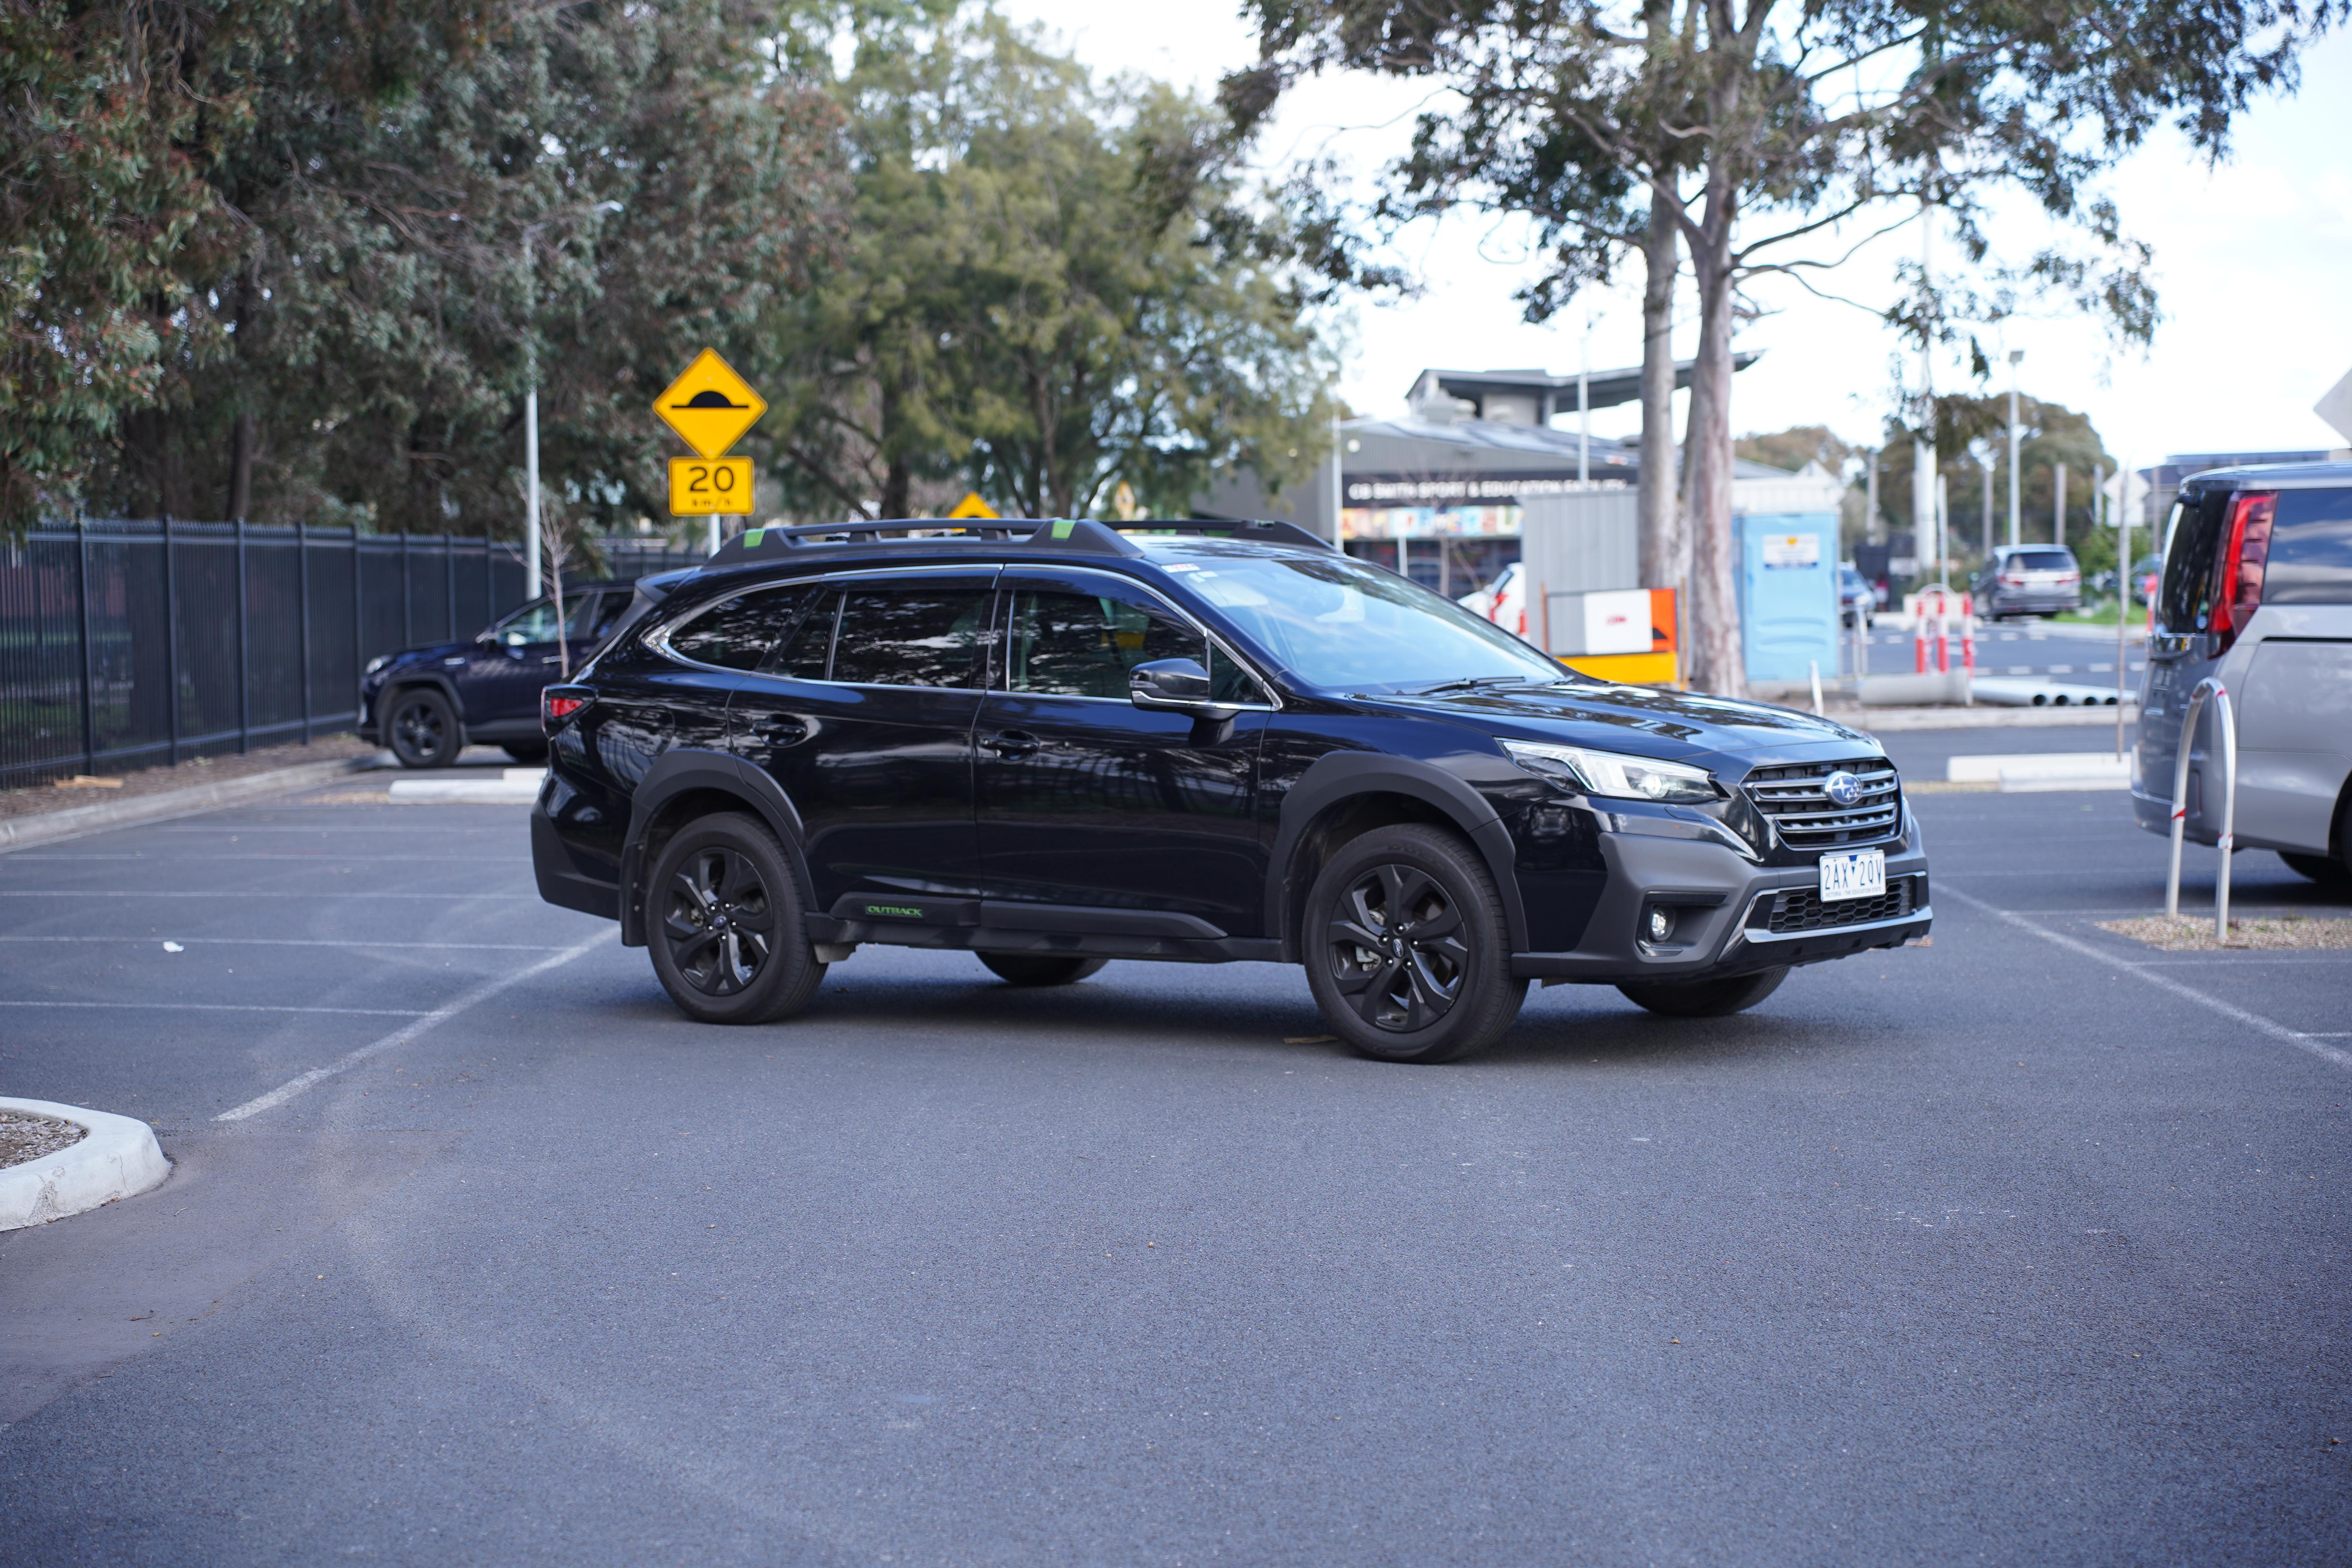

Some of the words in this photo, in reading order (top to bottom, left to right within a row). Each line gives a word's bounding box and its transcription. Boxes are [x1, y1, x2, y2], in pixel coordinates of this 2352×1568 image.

[690, 467, 734, 492] 20
[1373, 483, 1418, 499] SMITH
[1418, 481, 1466, 499] SPORT
[1467, 481, 1480, 498] &
[1481, 480, 1563, 498] EDUCATION
[1825, 863, 1848, 889] 2AX
[1859, 859, 1882, 886] 2QV
[867, 905, 922, 916] OUTBACK
